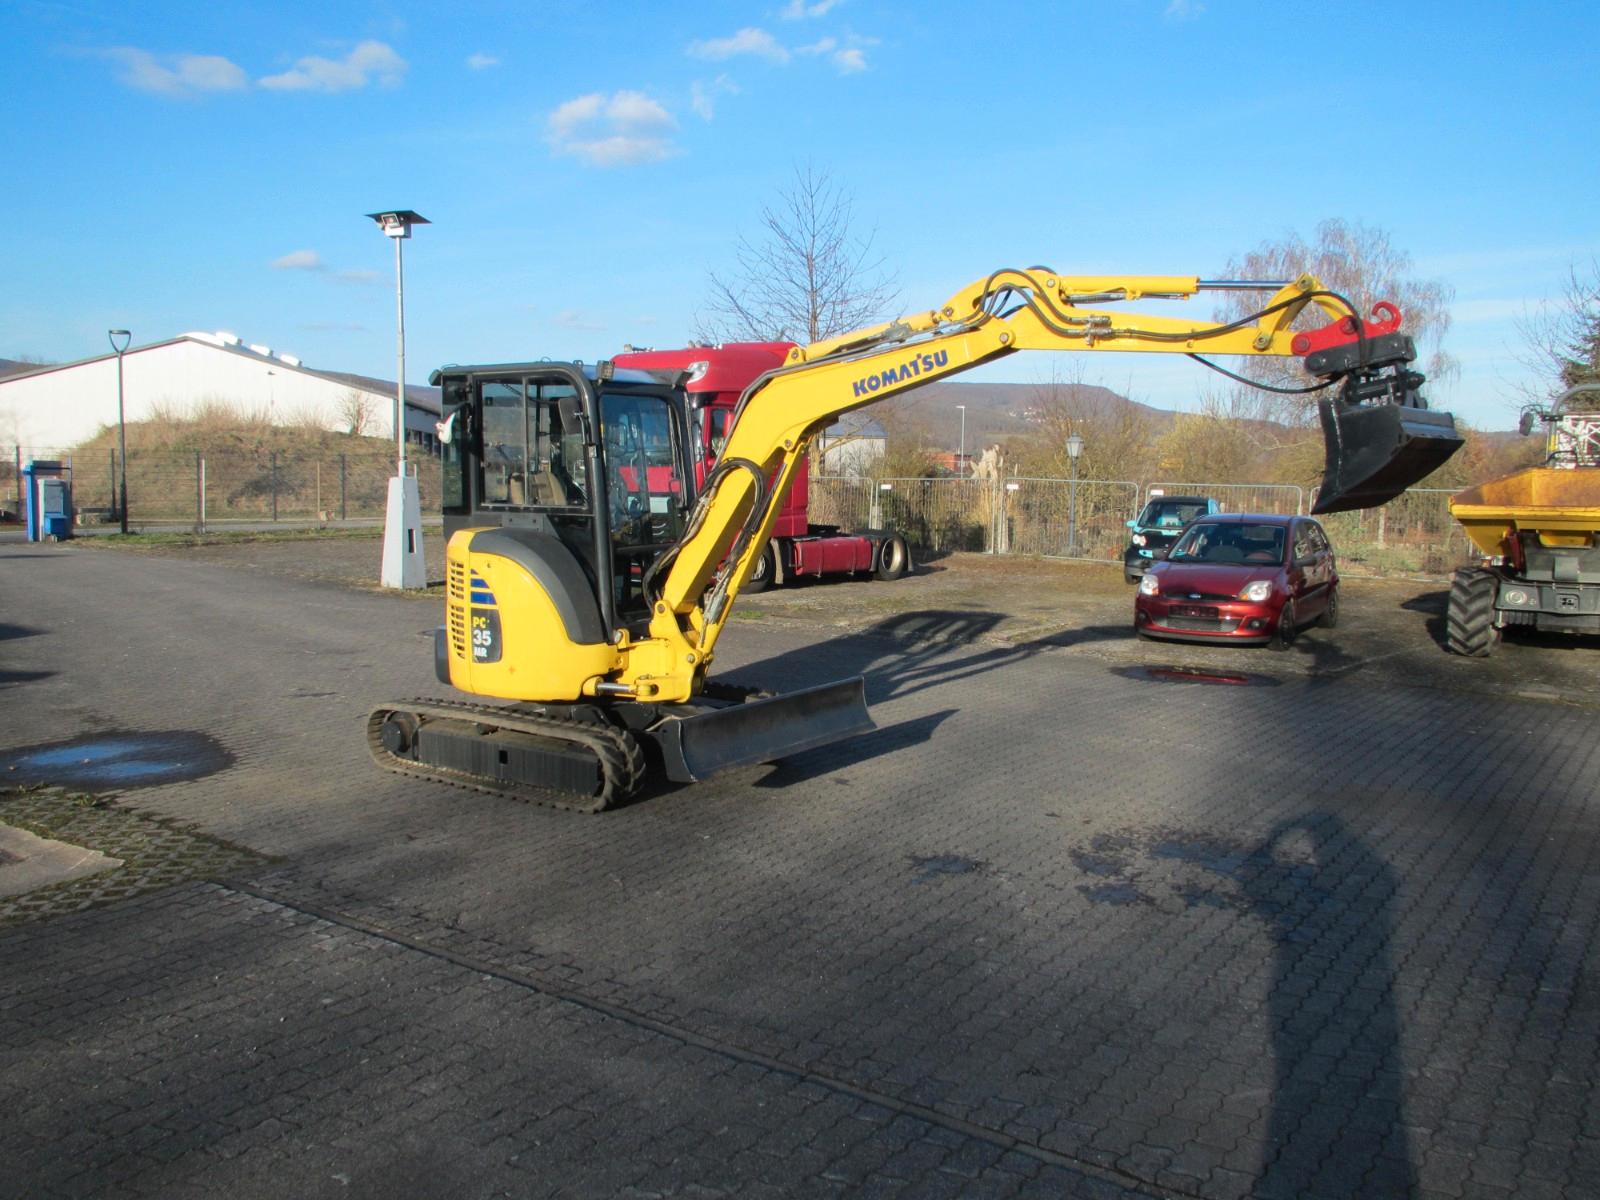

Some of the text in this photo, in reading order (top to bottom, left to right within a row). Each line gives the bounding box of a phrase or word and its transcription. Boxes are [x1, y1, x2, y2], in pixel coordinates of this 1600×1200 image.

[852, 349, 948, 397] KOMATSU
[473, 629, 492, 646] 35
[474, 646, 488, 658] MR
